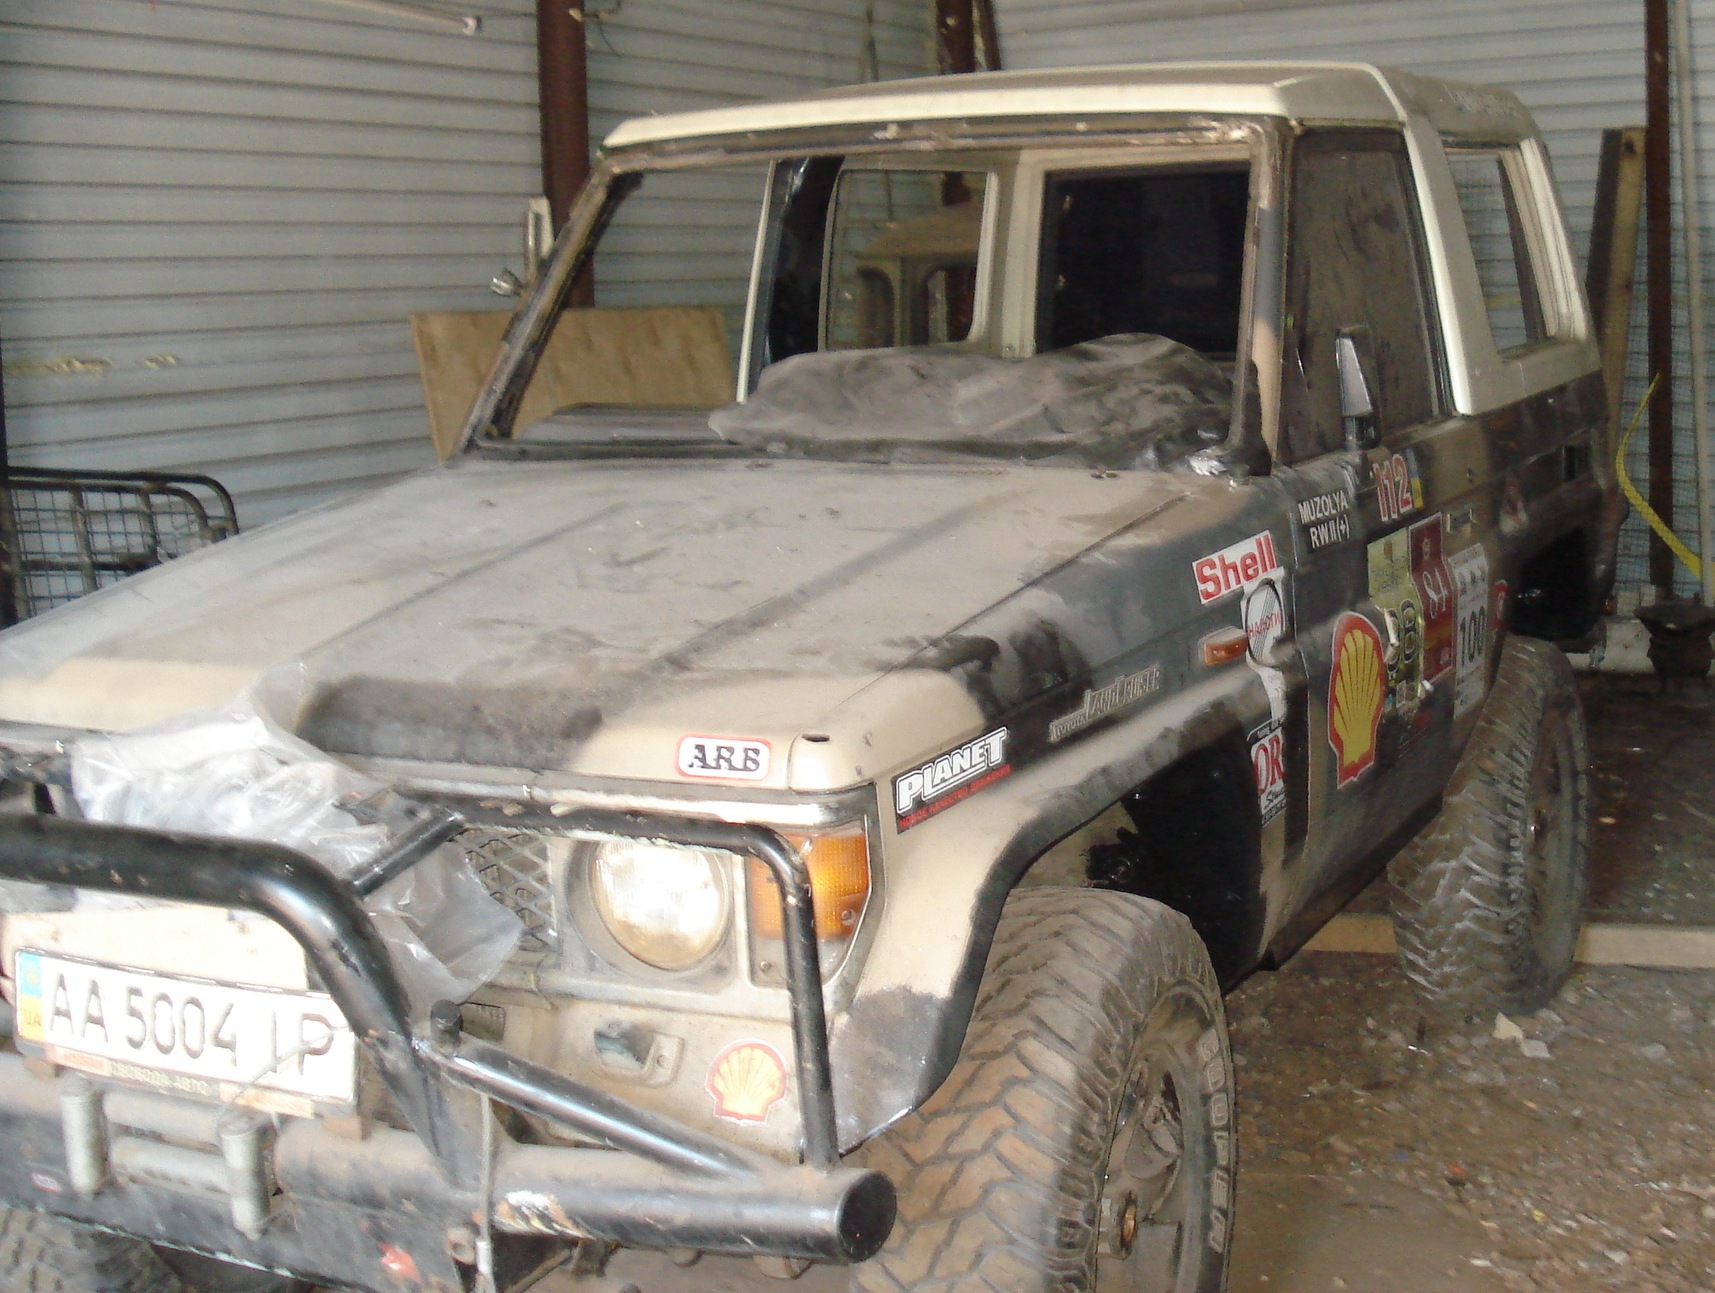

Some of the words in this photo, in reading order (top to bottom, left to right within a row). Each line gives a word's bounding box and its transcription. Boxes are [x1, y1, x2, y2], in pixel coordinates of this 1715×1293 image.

[1298, 489, 1349, 525] MUZOLYA
[1372, 454, 1413, 522] 112
[1195, 534, 1277, 601] Shell
[687, 743, 761, 773] ARB
[896, 726, 1008, 814] PLANET
[49, 972, 109, 1043] AA
[125, 985, 238, 1067] 5004
[271, 1008, 335, 1077] IP
